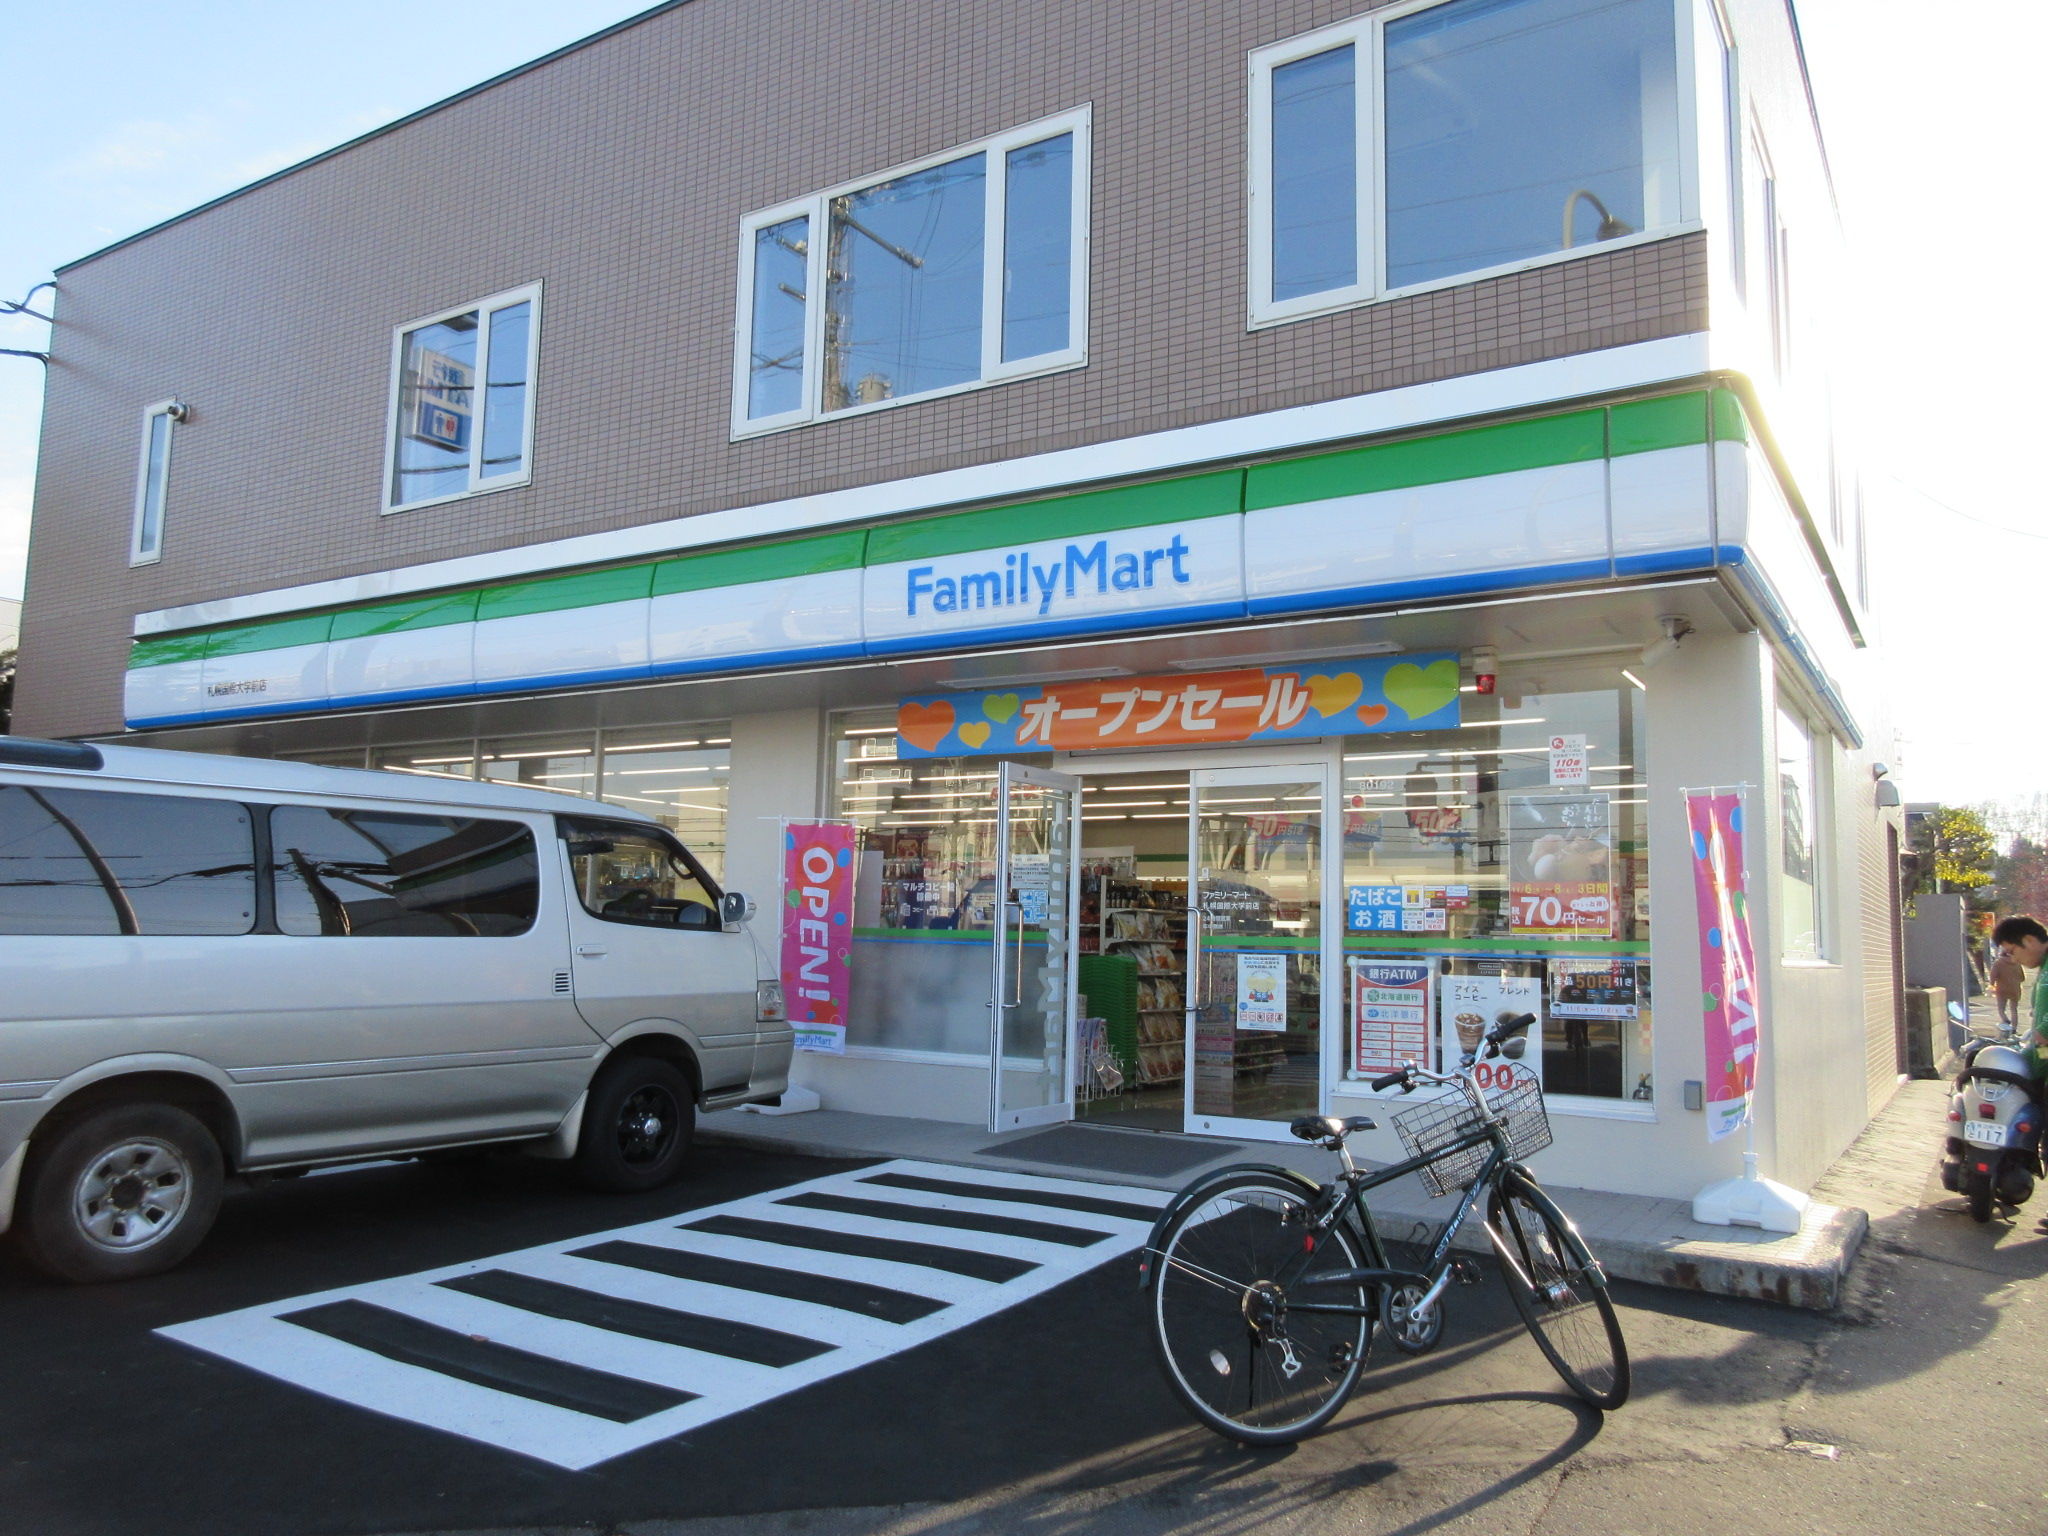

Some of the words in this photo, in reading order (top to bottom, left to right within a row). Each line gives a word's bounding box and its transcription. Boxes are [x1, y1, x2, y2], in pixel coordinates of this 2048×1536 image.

[908, 534, 1190, 616] FamilyMart
[1019, 677, 1308, 741] オープンセール
[1202, 891, 1251, 899] ファミリーマート
[1350, 887, 1402, 906] たばこ
[799, 846, 835, 1002] OPEN!
[1355, 910, 1396, 929] お酒
[1369, 968, 1417, 980] 銀行ATM
[1455, 985, 1479, 993] アイス
[1499, 986, 1530, 995] ブレンド
[1455, 993, 1488, 1001] コーヒー
